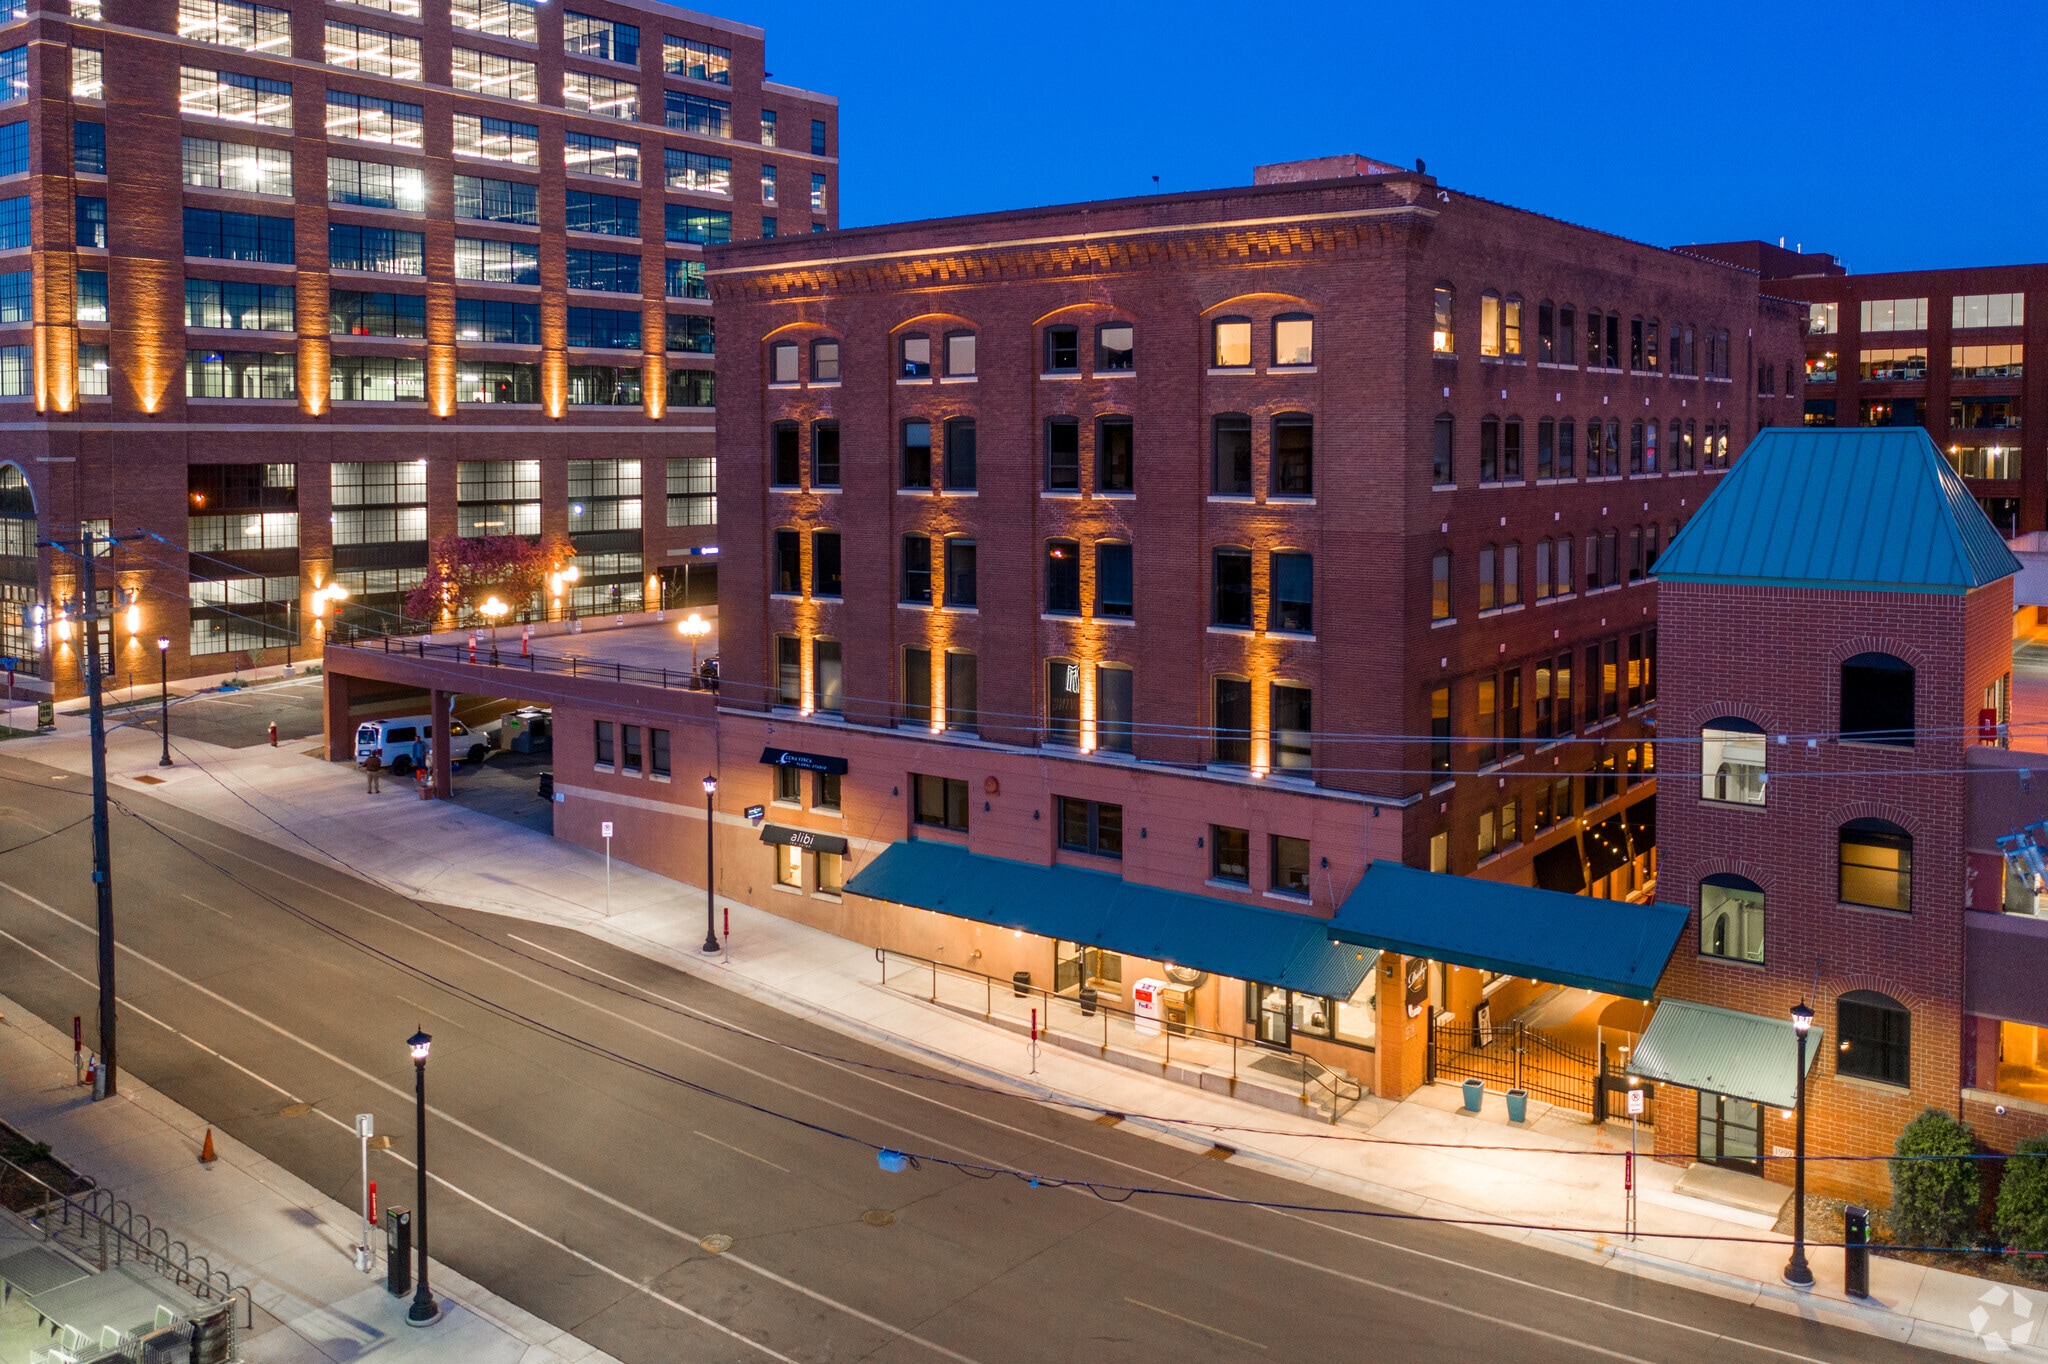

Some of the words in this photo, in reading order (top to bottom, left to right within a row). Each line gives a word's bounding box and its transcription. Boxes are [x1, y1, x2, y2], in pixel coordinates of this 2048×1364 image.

[790, 832, 815, 845] alibi
[1138, 1001, 1152, 1010] FedEx
[1775, 1147, 1793, 1157] 1999
